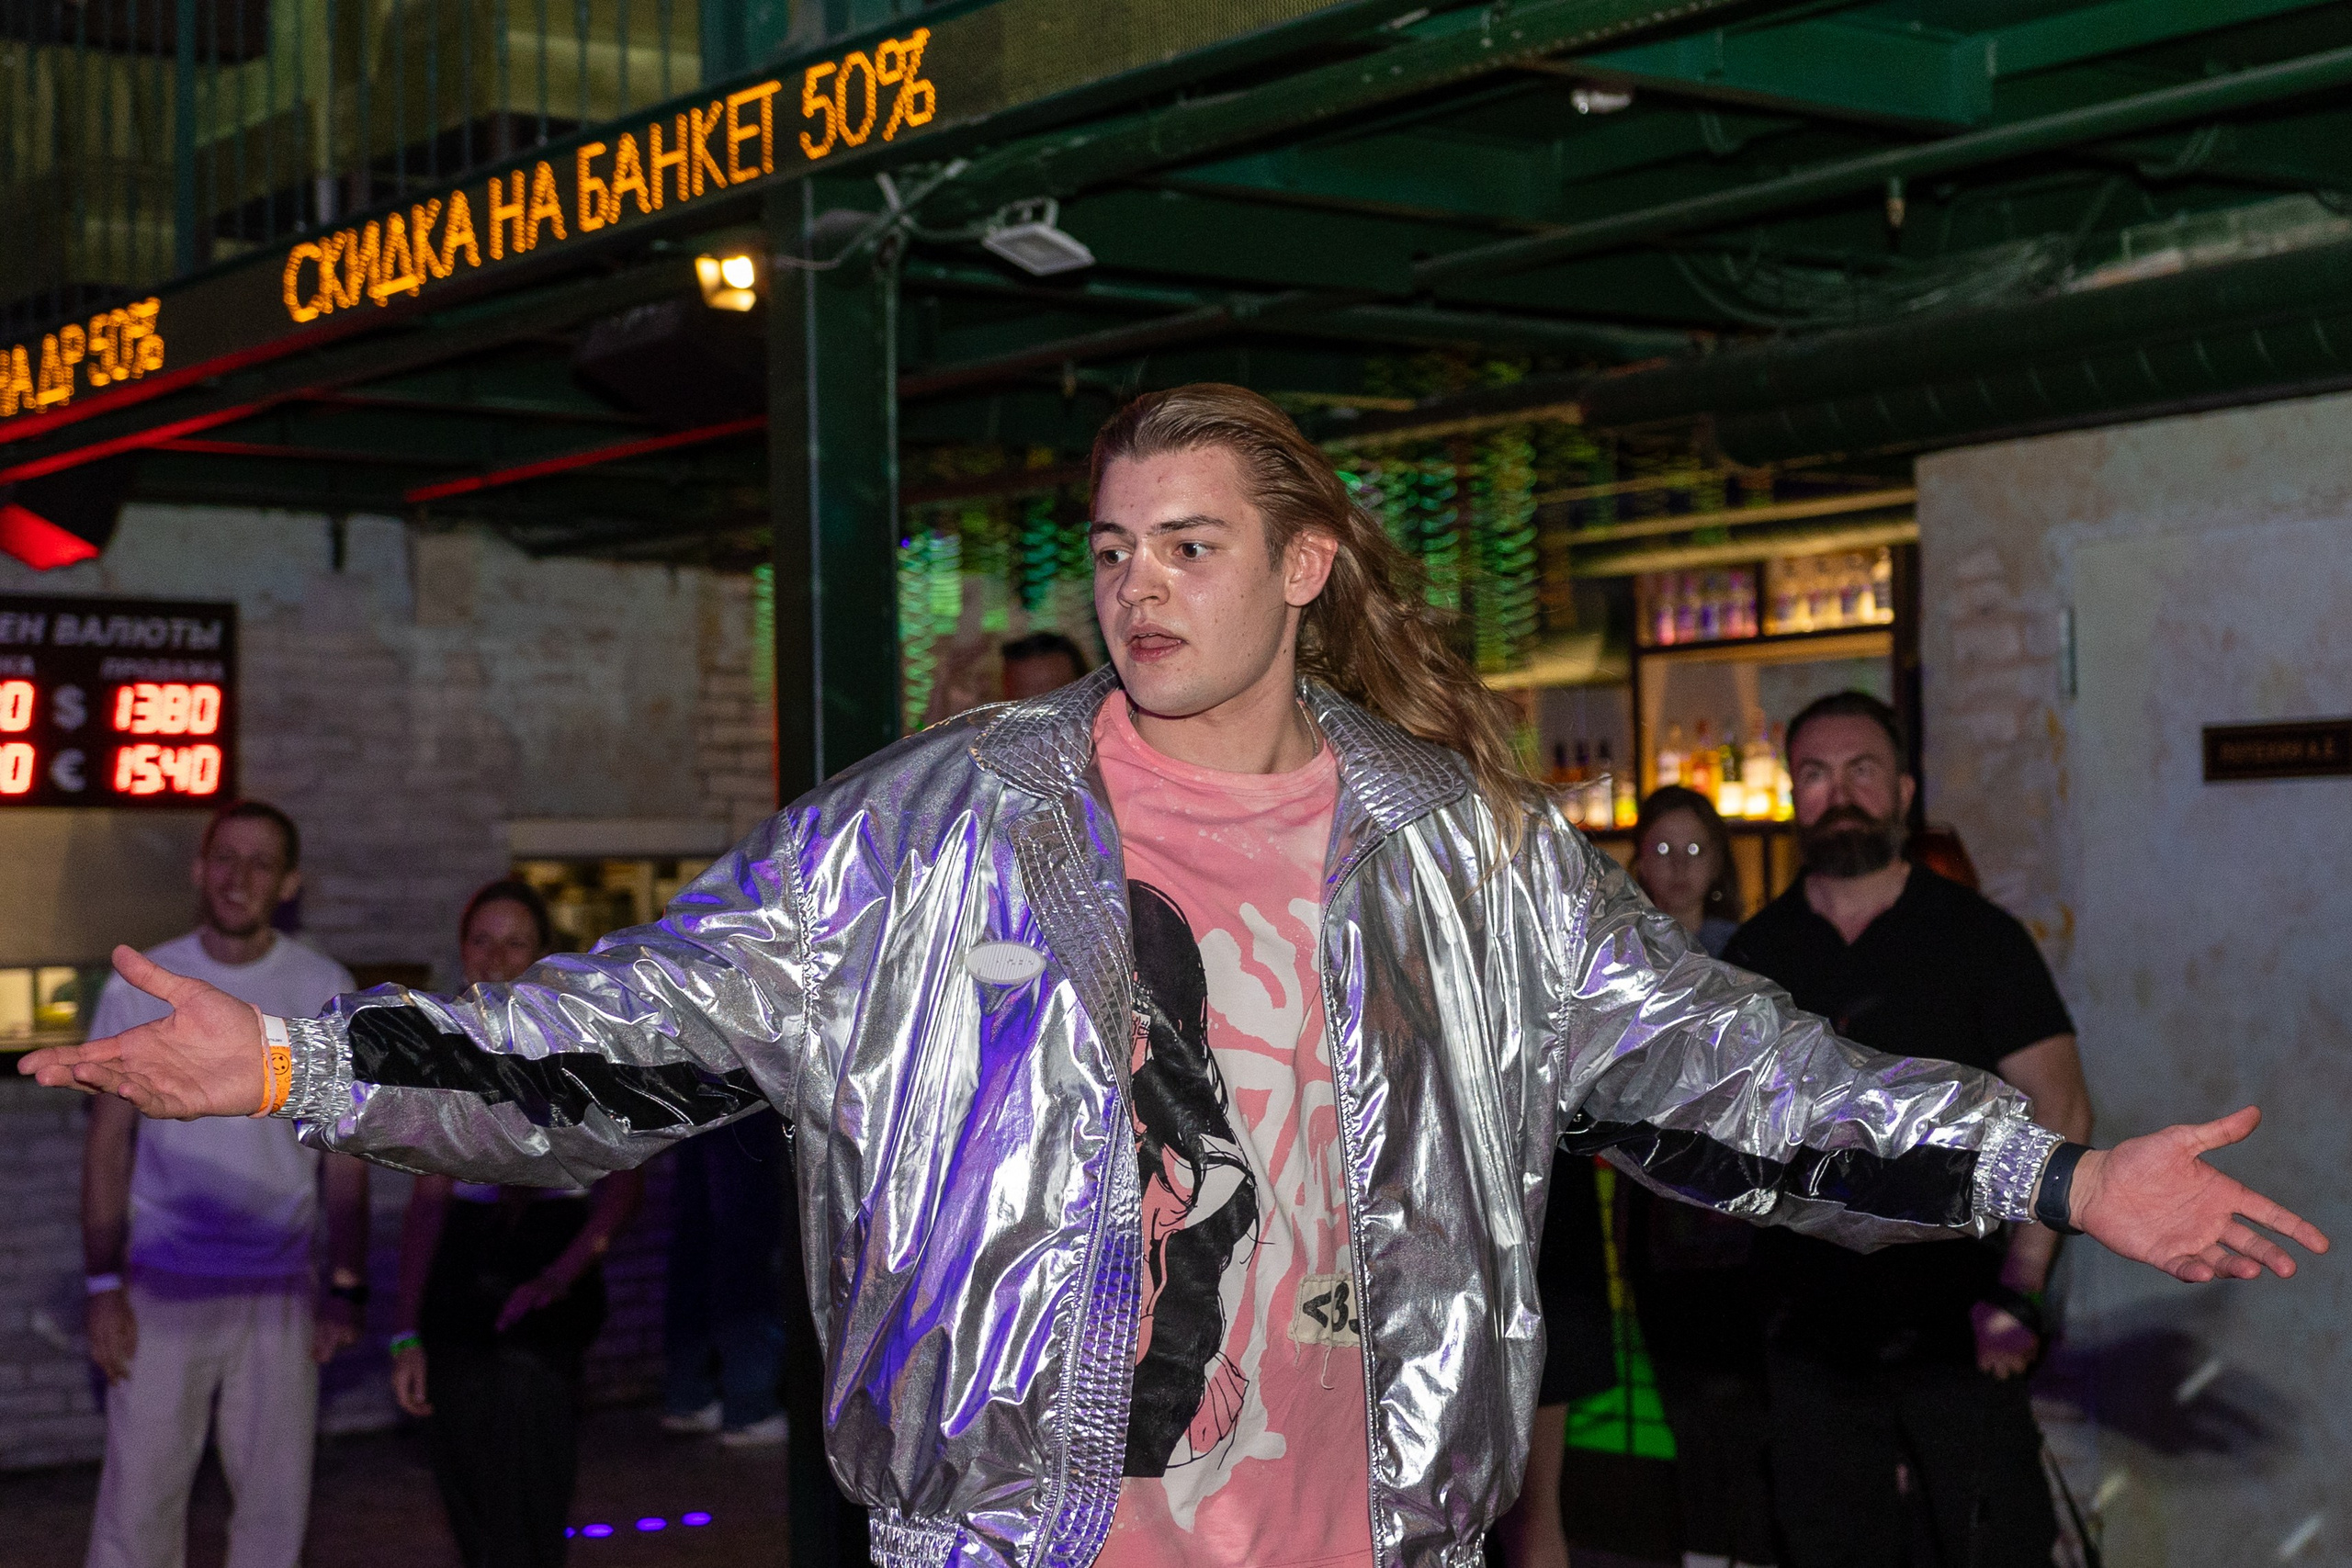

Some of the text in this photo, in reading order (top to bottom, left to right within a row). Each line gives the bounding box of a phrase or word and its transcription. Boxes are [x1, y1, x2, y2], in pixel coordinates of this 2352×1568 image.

[283, 27, 935, 322] СКИДКА НА БАНКЕТ 50%
[87, 297, 164, 387] 50%
[53, 614, 222, 649] ВАЛЮТЫ
[114, 682, 221, 735] 1380
[114, 744, 221, 795] 1540
